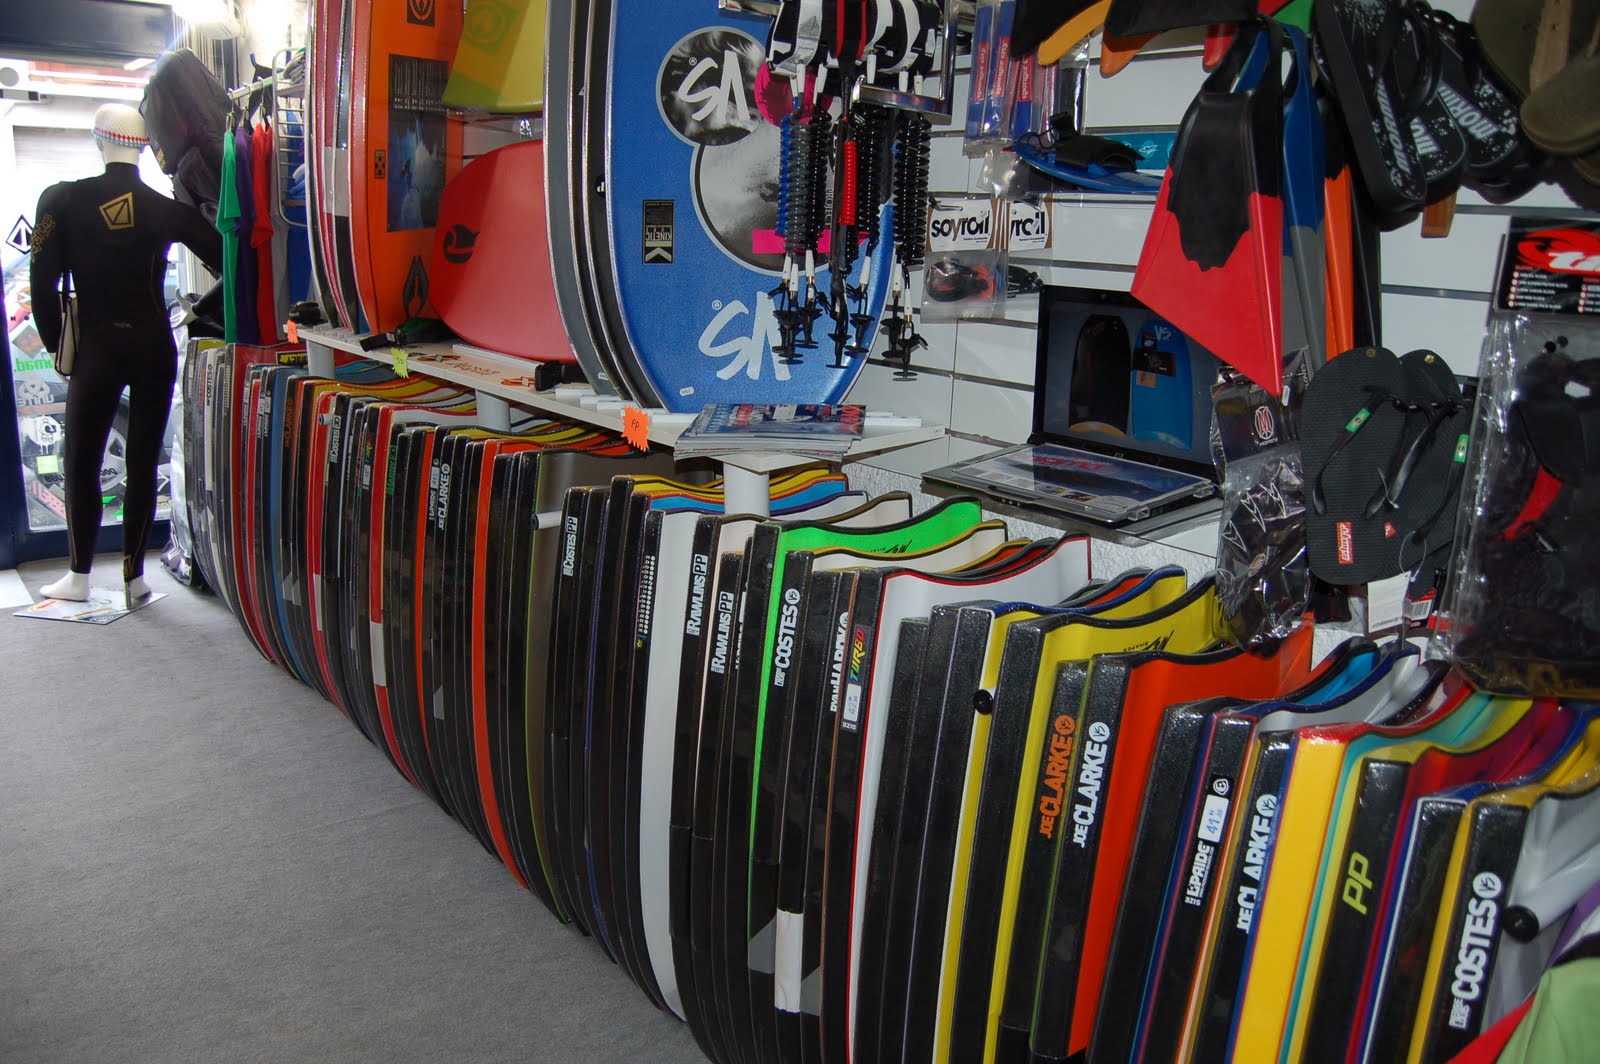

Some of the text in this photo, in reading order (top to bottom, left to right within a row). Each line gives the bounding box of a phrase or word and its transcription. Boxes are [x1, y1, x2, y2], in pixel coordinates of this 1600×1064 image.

[824, 186, 834, 229] PROJECT
[646, 231, 672, 241] KINETIC
[437, 474, 450, 518] CLARKE
[565, 516, 578, 535] PP
[564, 533, 577, 568] COSTES
[693, 554, 708, 576] PP
[687, 575, 706, 631] RAWLINS
[719, 591, 734, 613] PP
[712, 612, 732, 669] RAWLINS
[775, 604, 798, 669] COSTES
[849, 626, 866, 684] TURBO
[1039, 732, 1073, 817] CLARKE
[1073, 740, 1108, 827] CLARKE
[1039, 814, 1055, 839] JOE
[1072, 823, 1089, 848] JOE
[1342, 852, 1375, 915] PP
[1451, 898, 1497, 1001] COSTES
